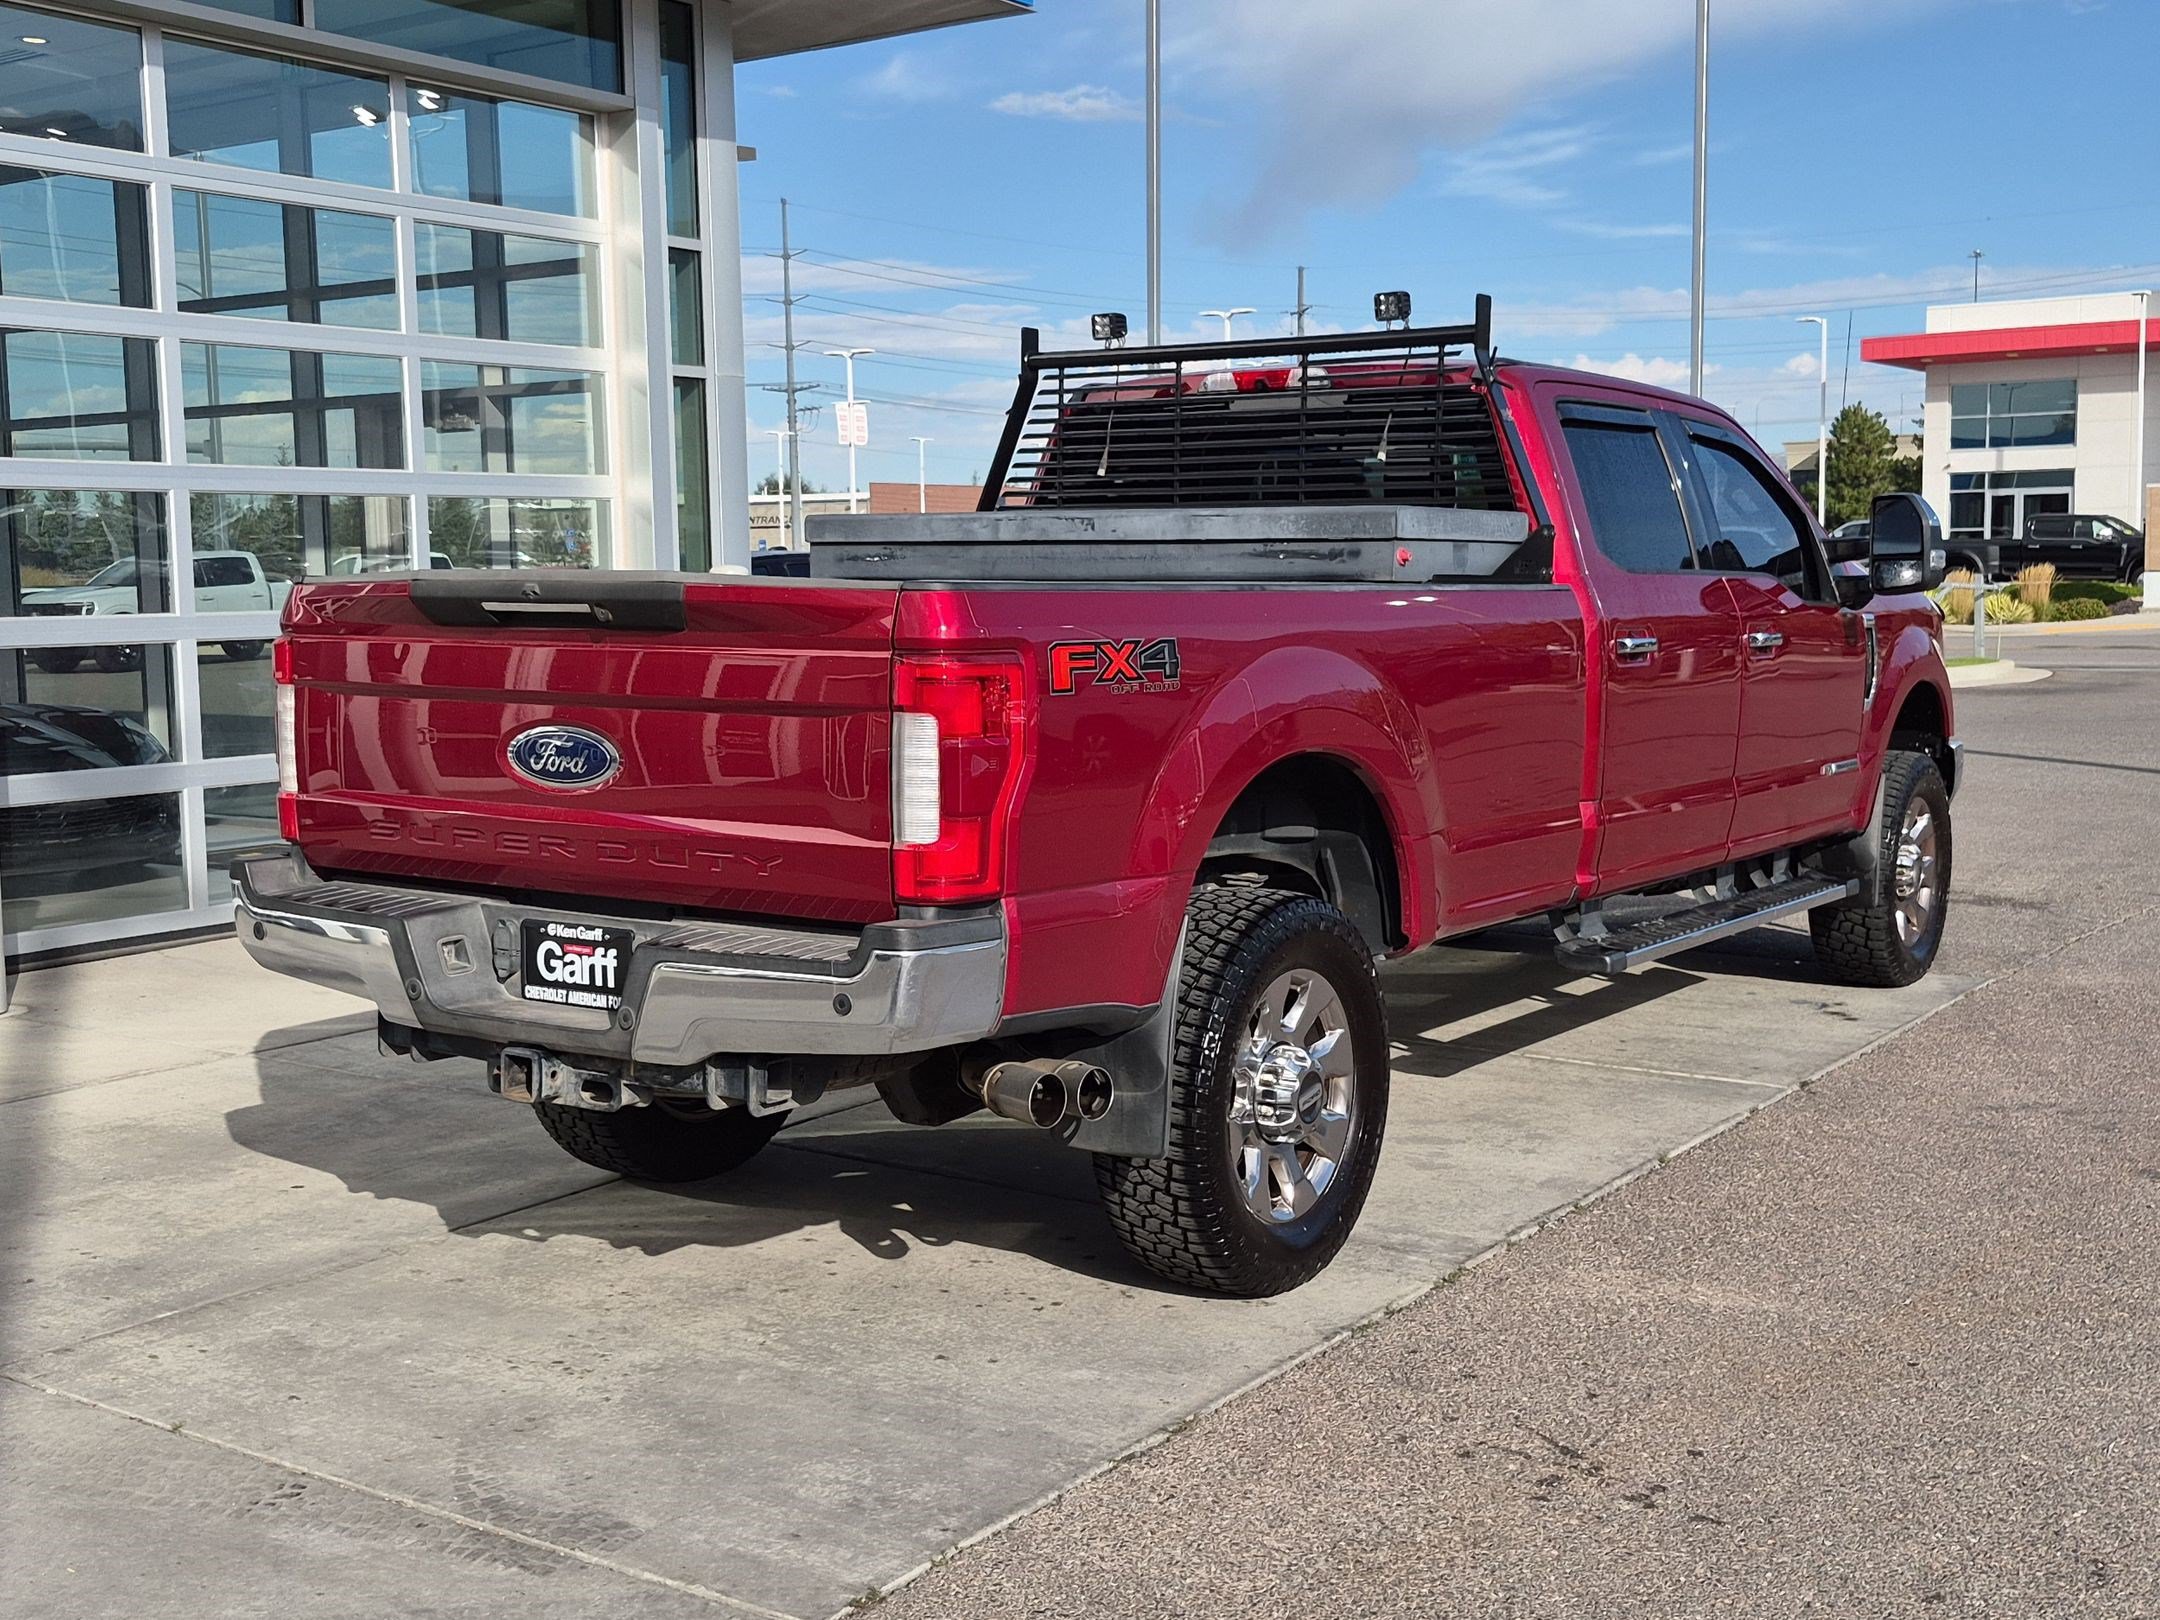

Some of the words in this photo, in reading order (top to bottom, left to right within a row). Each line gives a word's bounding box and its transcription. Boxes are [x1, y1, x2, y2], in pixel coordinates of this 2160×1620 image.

[1048, 637, 1181, 695] FX4
[1110, 683, 1140, 695] OFF
[1143, 681, 1181, 693] ROAD
[530, 738, 589, 773] Ford
[368, 819, 576, 859] SUPER
[597, 840, 784, 876] DUTY
[556, 924, 576, 938] Ken
[576, 926, 603, 941] Garff
[536, 940, 617, 988] Garff
[525, 985, 567, 1002] CHEVROLET
[568, 990, 607, 1008] AMERICAN
